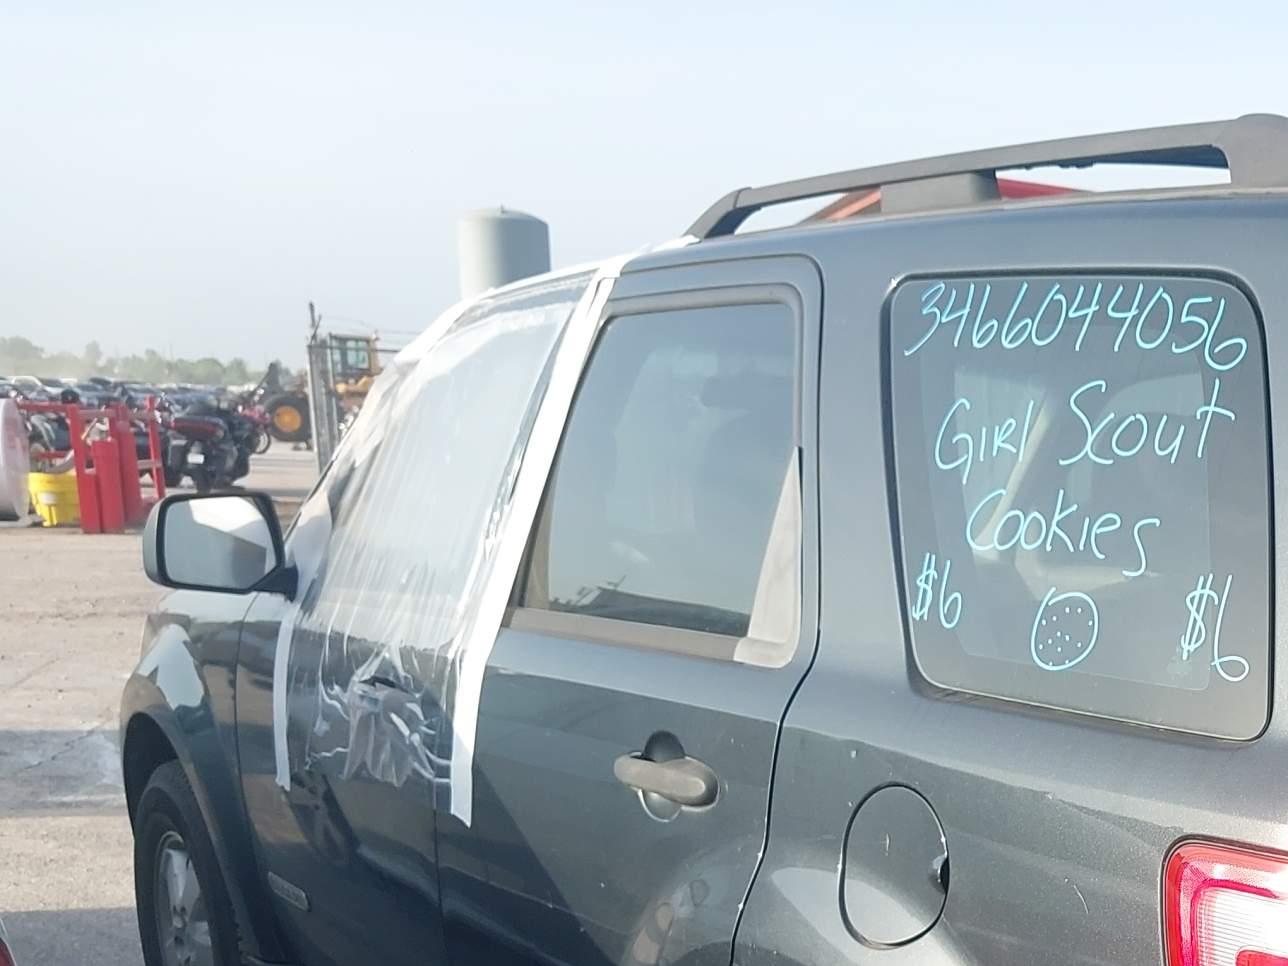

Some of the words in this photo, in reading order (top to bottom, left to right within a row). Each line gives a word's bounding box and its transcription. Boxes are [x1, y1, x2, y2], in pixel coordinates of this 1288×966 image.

[904, 281, 1247, 370] 3466044056
[1059, 377, 1235, 465] Scout
[912, 552, 963, 630] $6
[1181, 573, 1250, 682] $6
